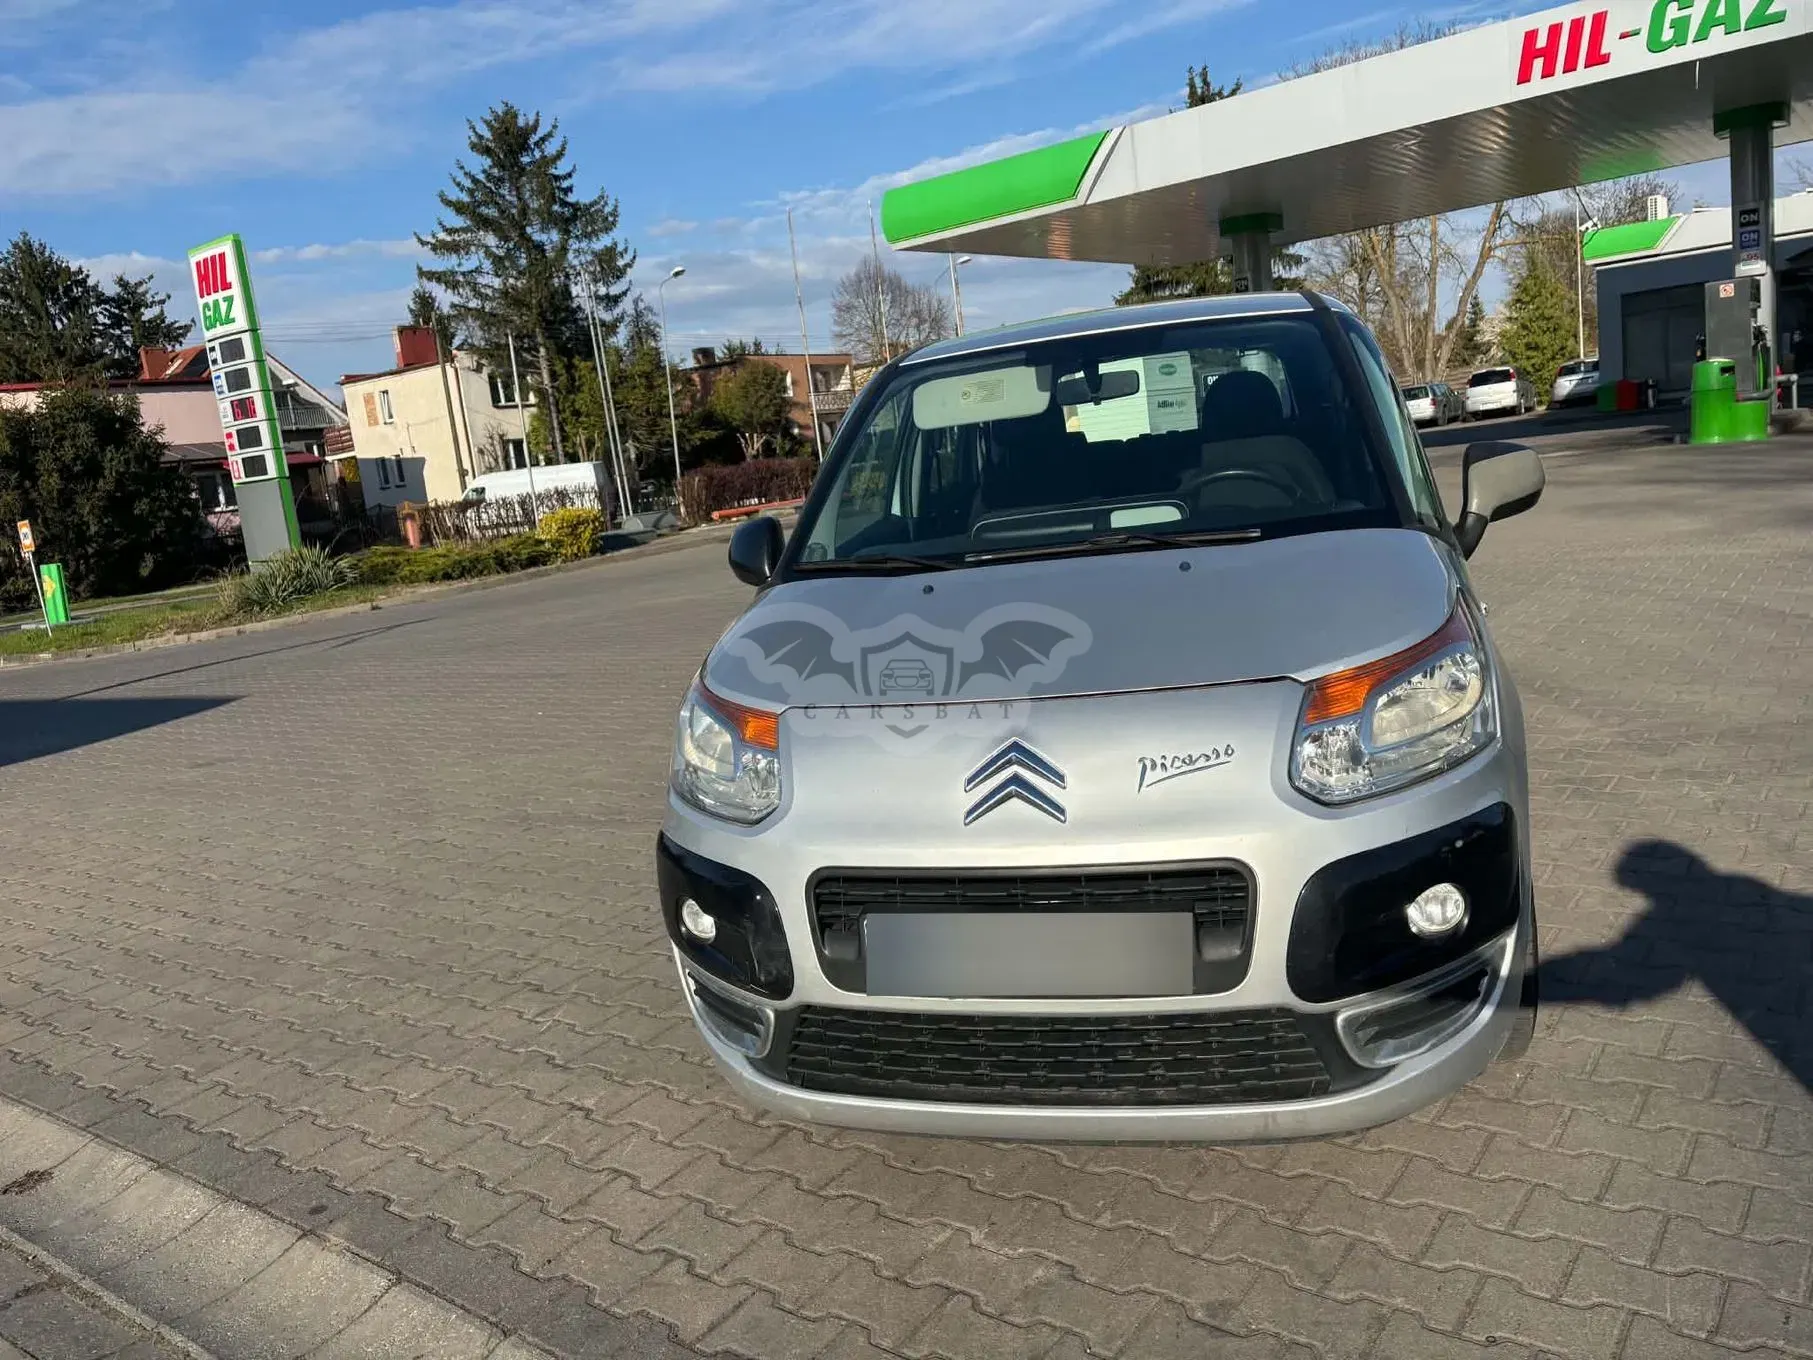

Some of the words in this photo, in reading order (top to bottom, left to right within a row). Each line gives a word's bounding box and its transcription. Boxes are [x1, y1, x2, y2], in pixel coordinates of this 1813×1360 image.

[1517, 0, 1787, 85] HIL-GAZ
[1741, 212, 1758, 222] ON
[196, 252, 232, 297] HIL
[203, 296, 235, 332] GAZ
